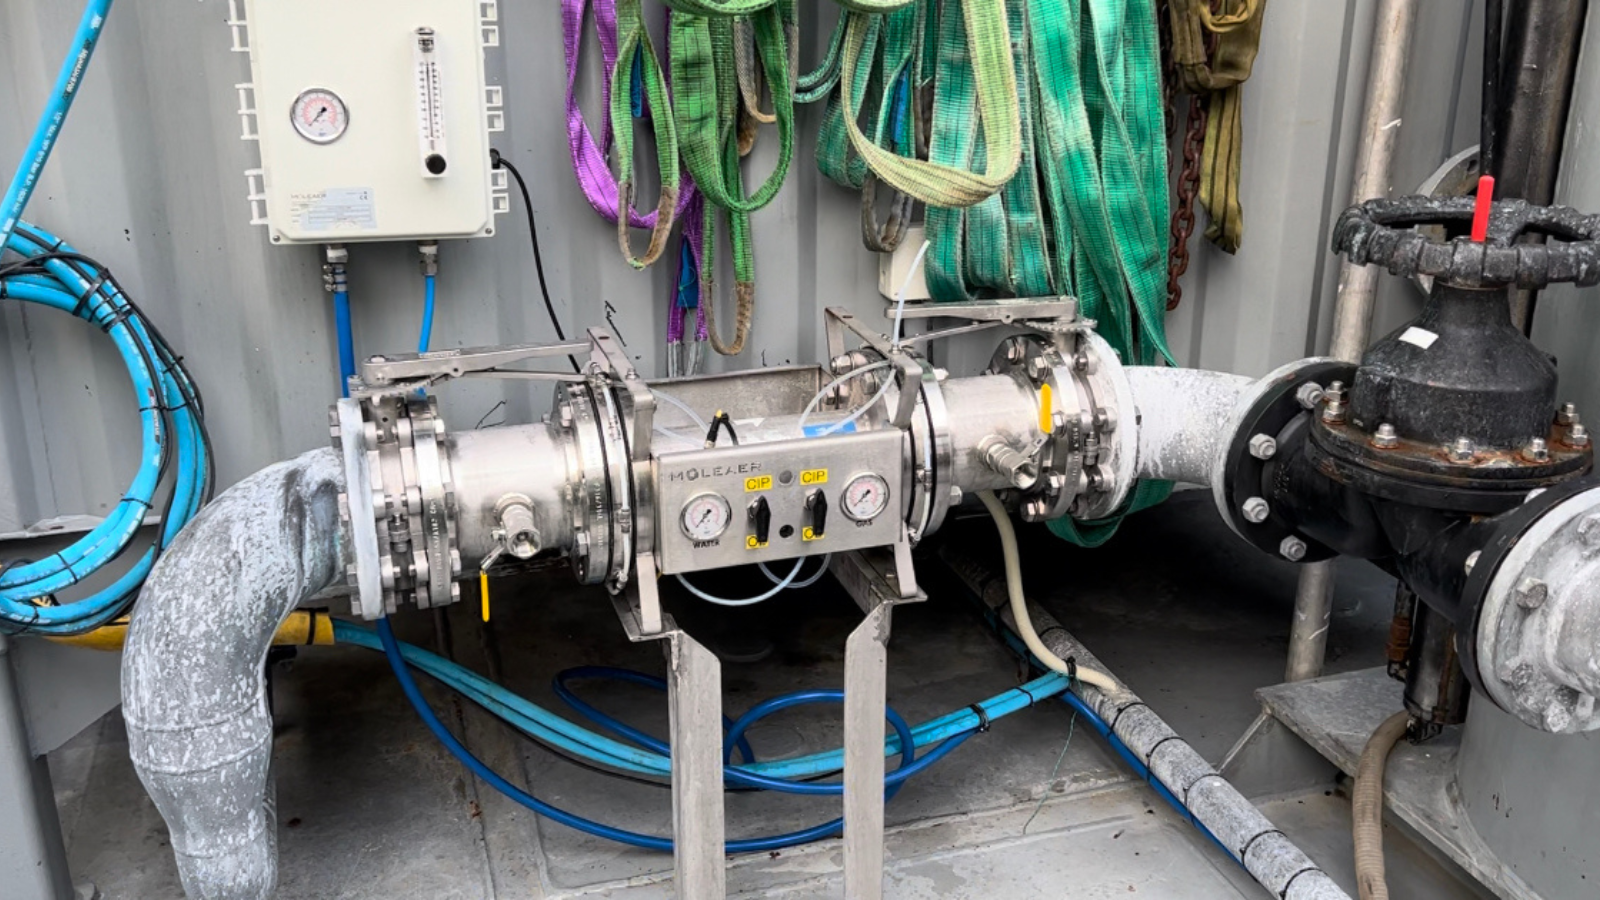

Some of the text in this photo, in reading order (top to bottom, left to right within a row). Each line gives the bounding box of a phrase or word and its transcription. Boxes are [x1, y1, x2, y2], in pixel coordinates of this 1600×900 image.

[746, 476, 771, 490] CIP
[803, 470, 825, 483] CIP
[693, 539, 720, 549] WATER
